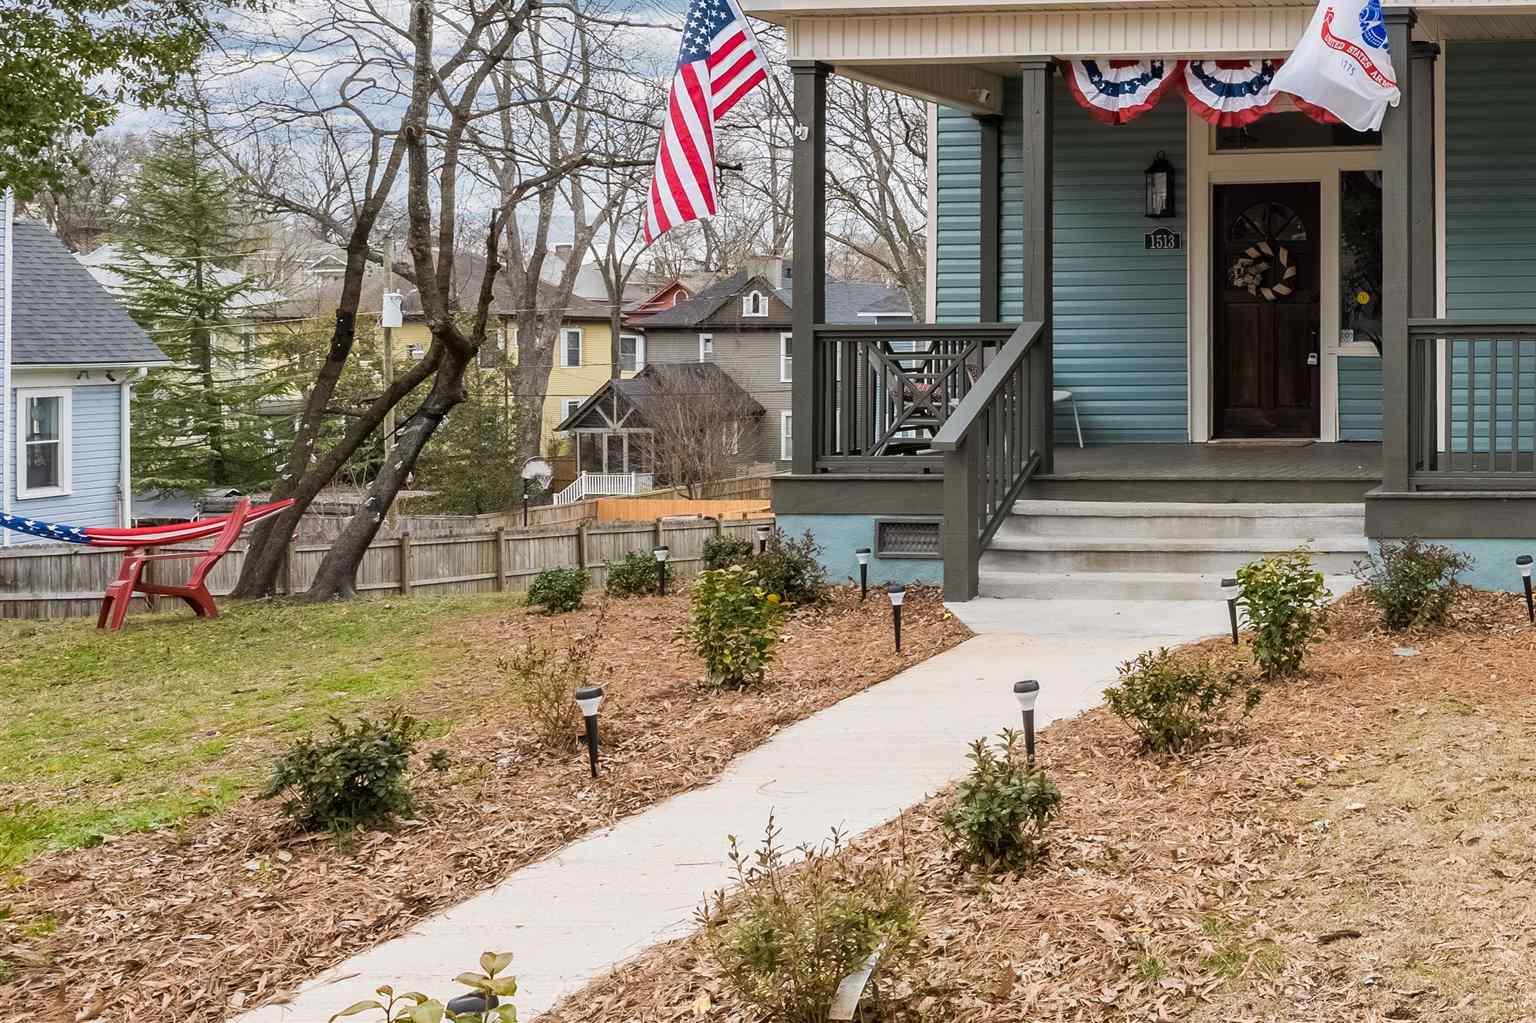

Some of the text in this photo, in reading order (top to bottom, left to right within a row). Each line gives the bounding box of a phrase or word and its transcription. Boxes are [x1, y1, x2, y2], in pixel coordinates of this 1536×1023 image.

[1326, 34, 1345, 49] UNITED
[1348, 46, 1373, 67] STATES
[1149, 235, 1175, 249] 1513
